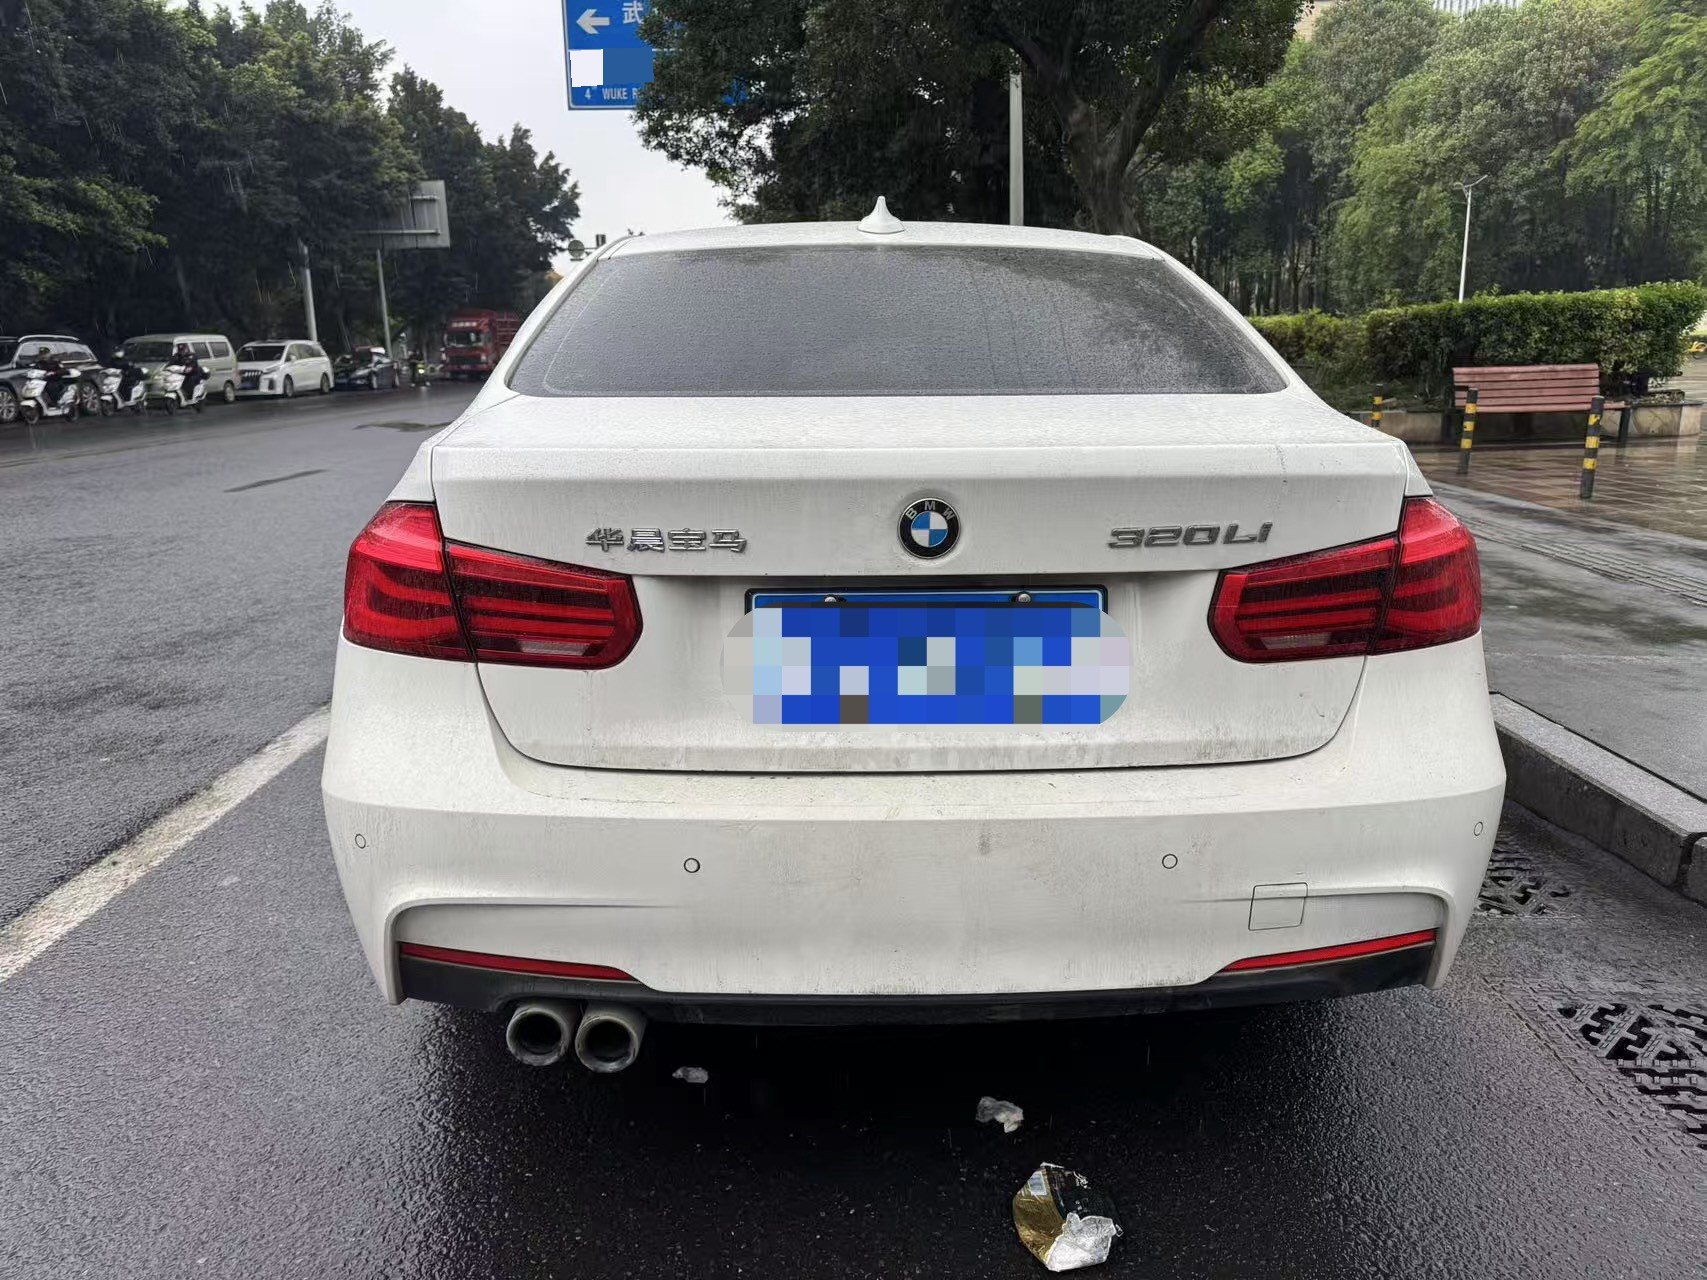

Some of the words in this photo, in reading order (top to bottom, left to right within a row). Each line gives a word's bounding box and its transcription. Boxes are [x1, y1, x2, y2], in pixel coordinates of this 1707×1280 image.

[602, 87, 628, 100] WUKE
[905, 500, 955, 520] BMW
[585, 527, 747, 552] 华晨宝马
